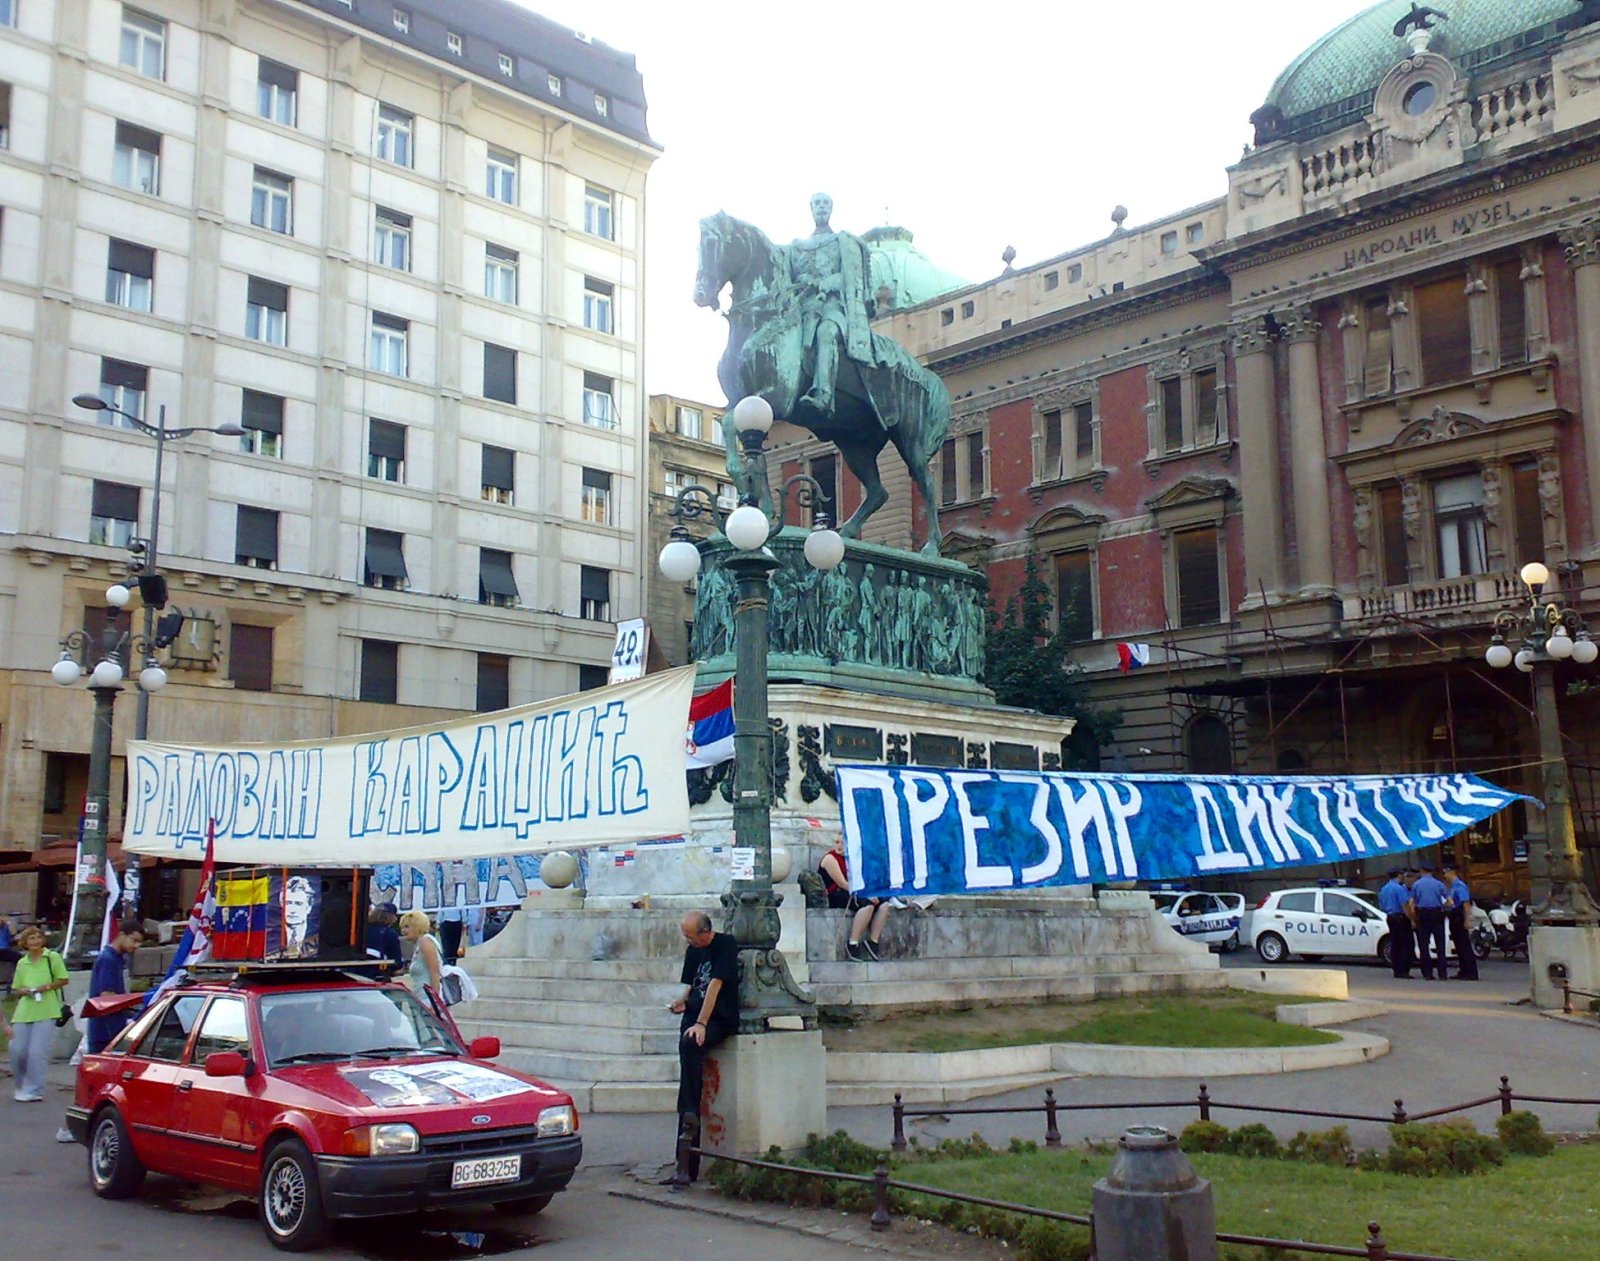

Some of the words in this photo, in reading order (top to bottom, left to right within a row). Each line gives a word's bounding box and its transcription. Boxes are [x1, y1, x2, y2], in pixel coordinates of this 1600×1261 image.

[1344, 225, 1437, 269] НАРОДНИ
[132, 748, 322, 849] РАДОВАН
[349, 701, 648, 839] КАРАЏИЋ
[837, 768, 1142, 890] ПРЕЗИР
[1186, 774, 1517, 870] ДИКТАТУРИ
[1285, 921, 1369, 937] POLICIJA
